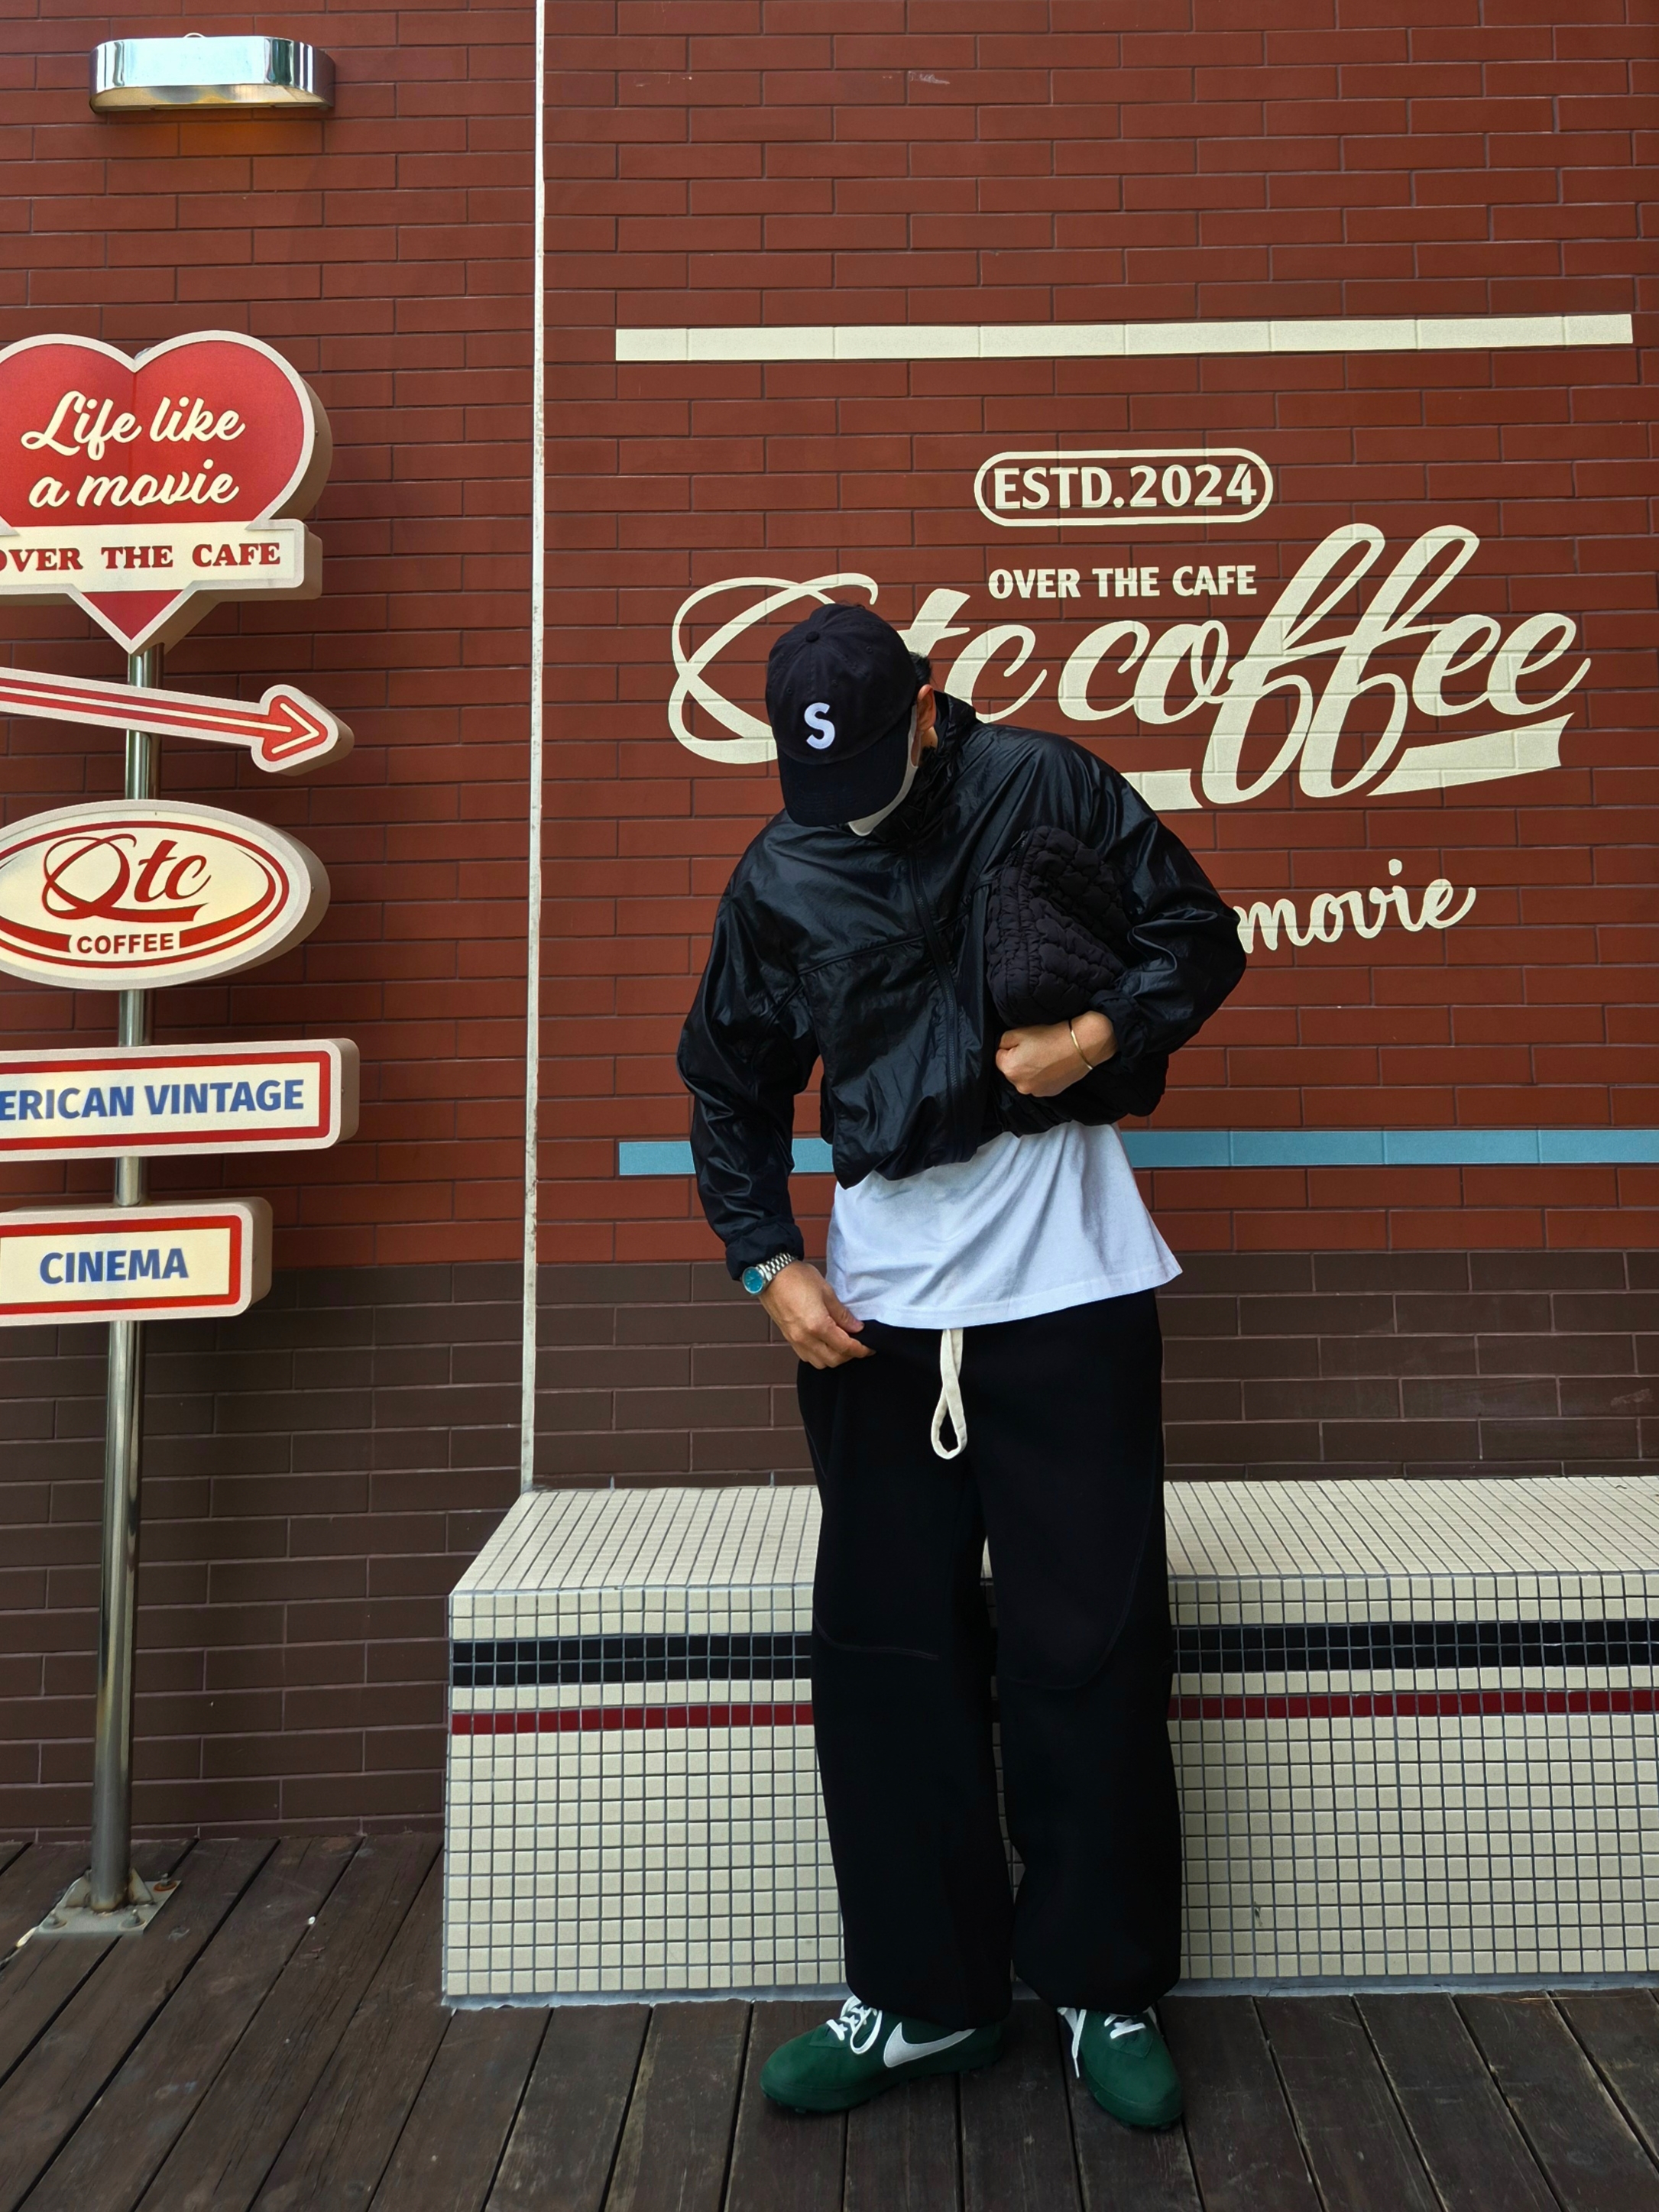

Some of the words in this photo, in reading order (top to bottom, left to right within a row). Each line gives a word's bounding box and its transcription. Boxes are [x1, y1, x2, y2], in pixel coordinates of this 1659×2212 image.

[21, 390, 142, 460] Life
[149, 397, 245, 442] like
[28, 476, 70, 508] a
[76, 458, 239, 507] movie
[994, 463, 1257, 509] ESTD.2024
[0, 548, 83, 572] VER
[101, 545, 173, 568] THE
[192, 542, 281, 567] CAFE
[988, 567, 1081, 599] OVER
[1092, 566, 1160, 598] THE
[1172, 565, 1257, 596] CAFE
[1058, 523, 1591, 805] coffee
[804, 702, 835, 750] S
[1233, 858, 1476, 954] movie
[76, 932, 174, 954] COFFEE
[0, 1086, 134, 1121] ERICAN
[144, 1079, 304, 1116] VINTAGE
[40, 1248, 189, 1284] CINEMA
